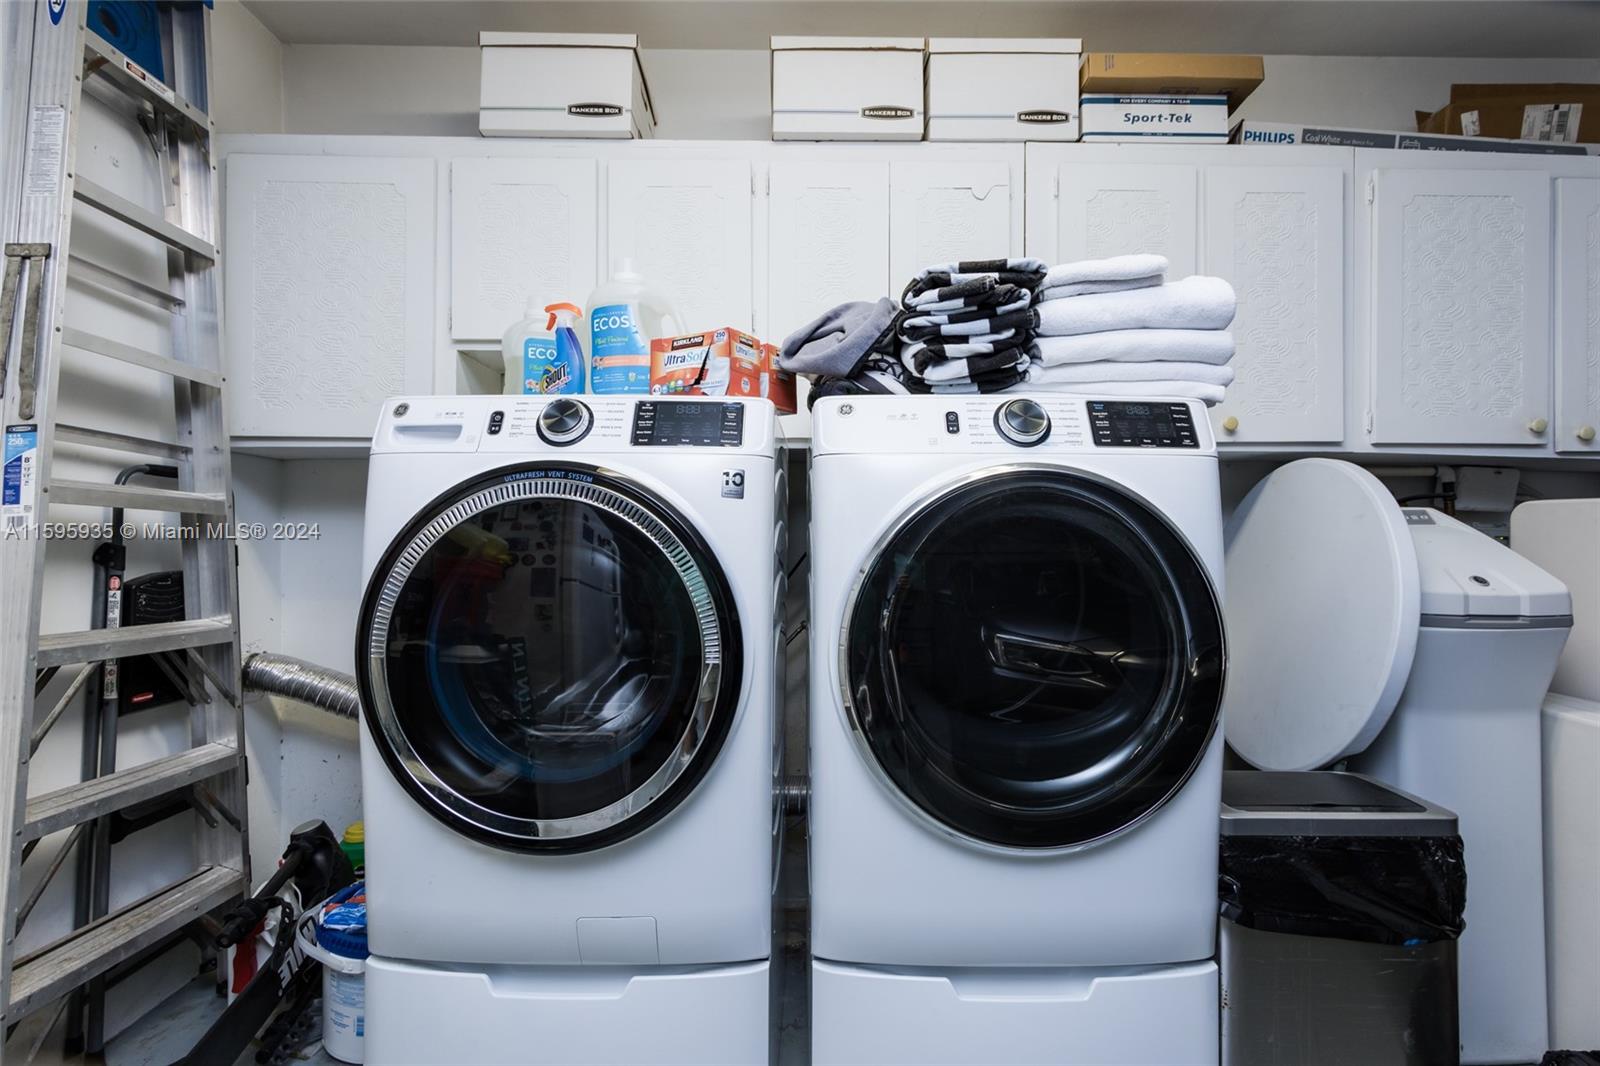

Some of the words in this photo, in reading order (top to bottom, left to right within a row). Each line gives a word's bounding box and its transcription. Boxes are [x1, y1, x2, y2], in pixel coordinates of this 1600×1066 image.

[1123, 112, 1193, 125] Sport-Tek
[1244, 130, 1296, 145] PHILIPS
[593, 315, 631, 332] ECOS
[673, 336, 704, 347] KIRKLAND
[528, 347, 557, 361] ECO
[504, 470, 545, 482] ULTRAFRESH
[547, 470, 566, 479] VENT
[567, 472, 594, 483] SYSTEM
[722, 471, 744, 488] 10
